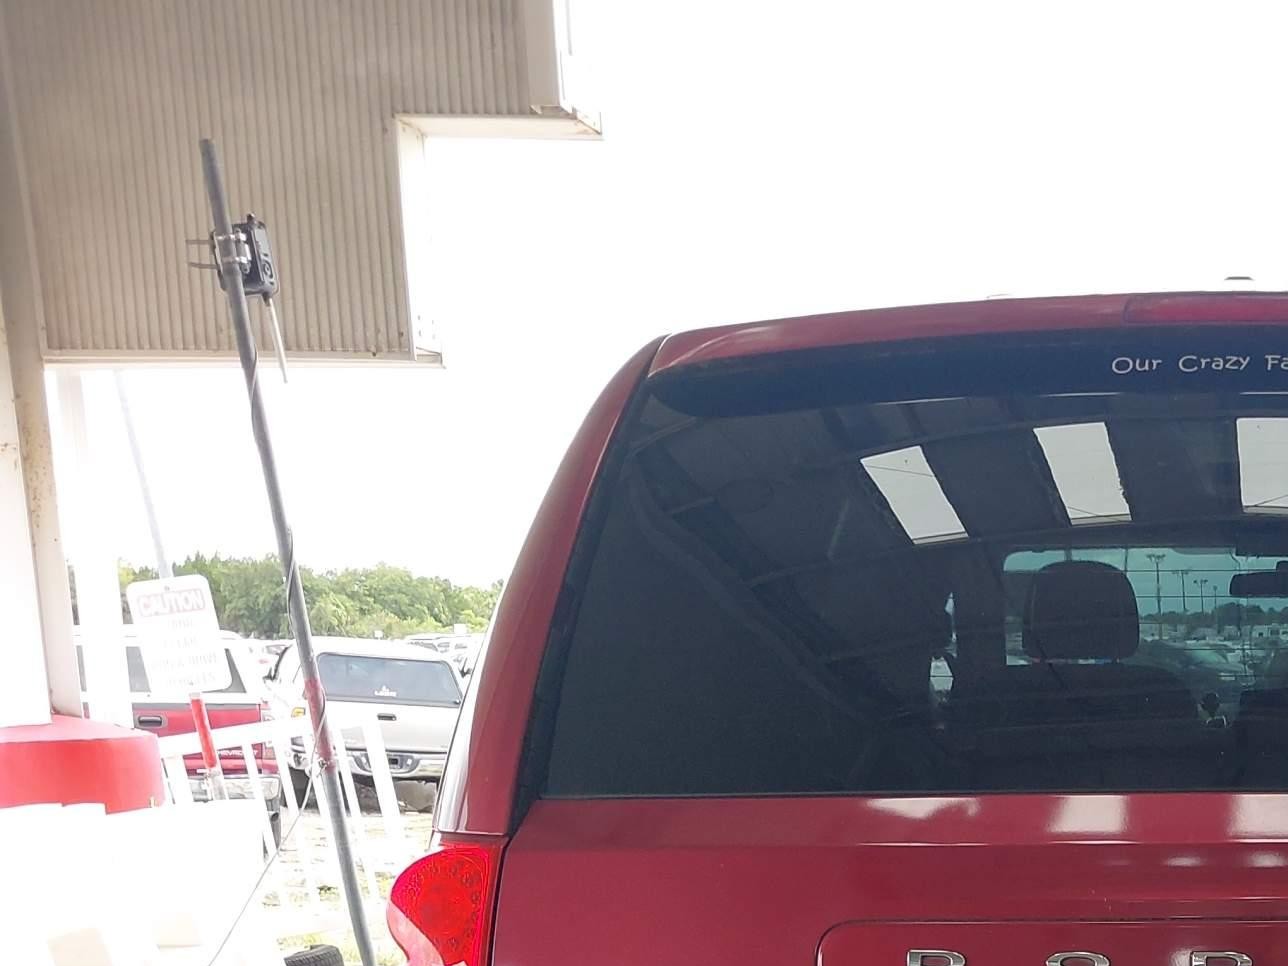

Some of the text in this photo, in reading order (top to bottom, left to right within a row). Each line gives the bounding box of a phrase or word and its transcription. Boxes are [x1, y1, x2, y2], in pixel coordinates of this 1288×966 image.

[1111, 356, 1163, 374] Our
[1178, 355, 1251, 372] Crazy
[138, 589, 205, 617] CAUTION
